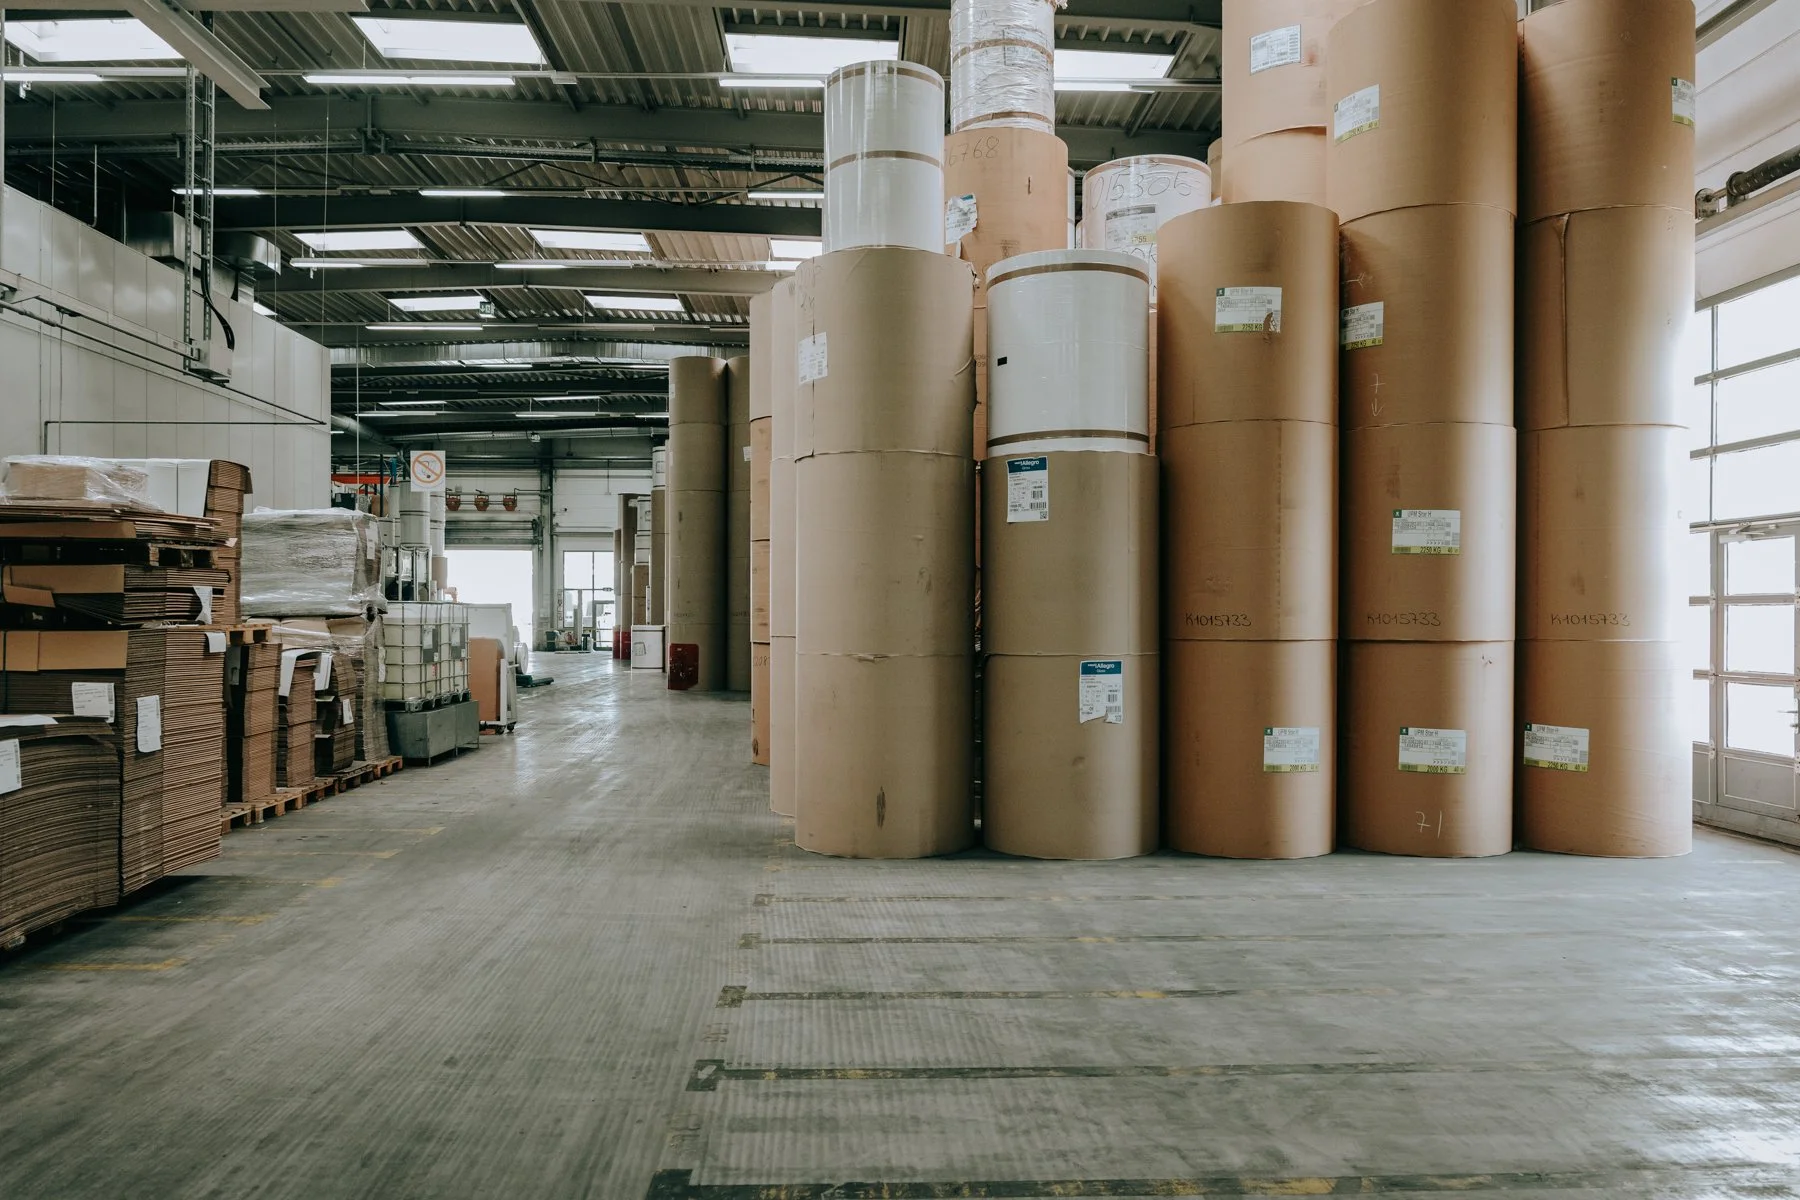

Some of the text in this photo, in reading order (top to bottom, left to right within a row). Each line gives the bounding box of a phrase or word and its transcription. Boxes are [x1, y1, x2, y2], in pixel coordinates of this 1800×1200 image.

[1420, 546, 1441, 554] 2250 KG
[1185, 612, 1252, 627] K1015733
[1550, 612, 1631, 627] K1015733
[1439, 765, 1448, 773] KG
[1547, 761, 1568, 771] 2250 KG
